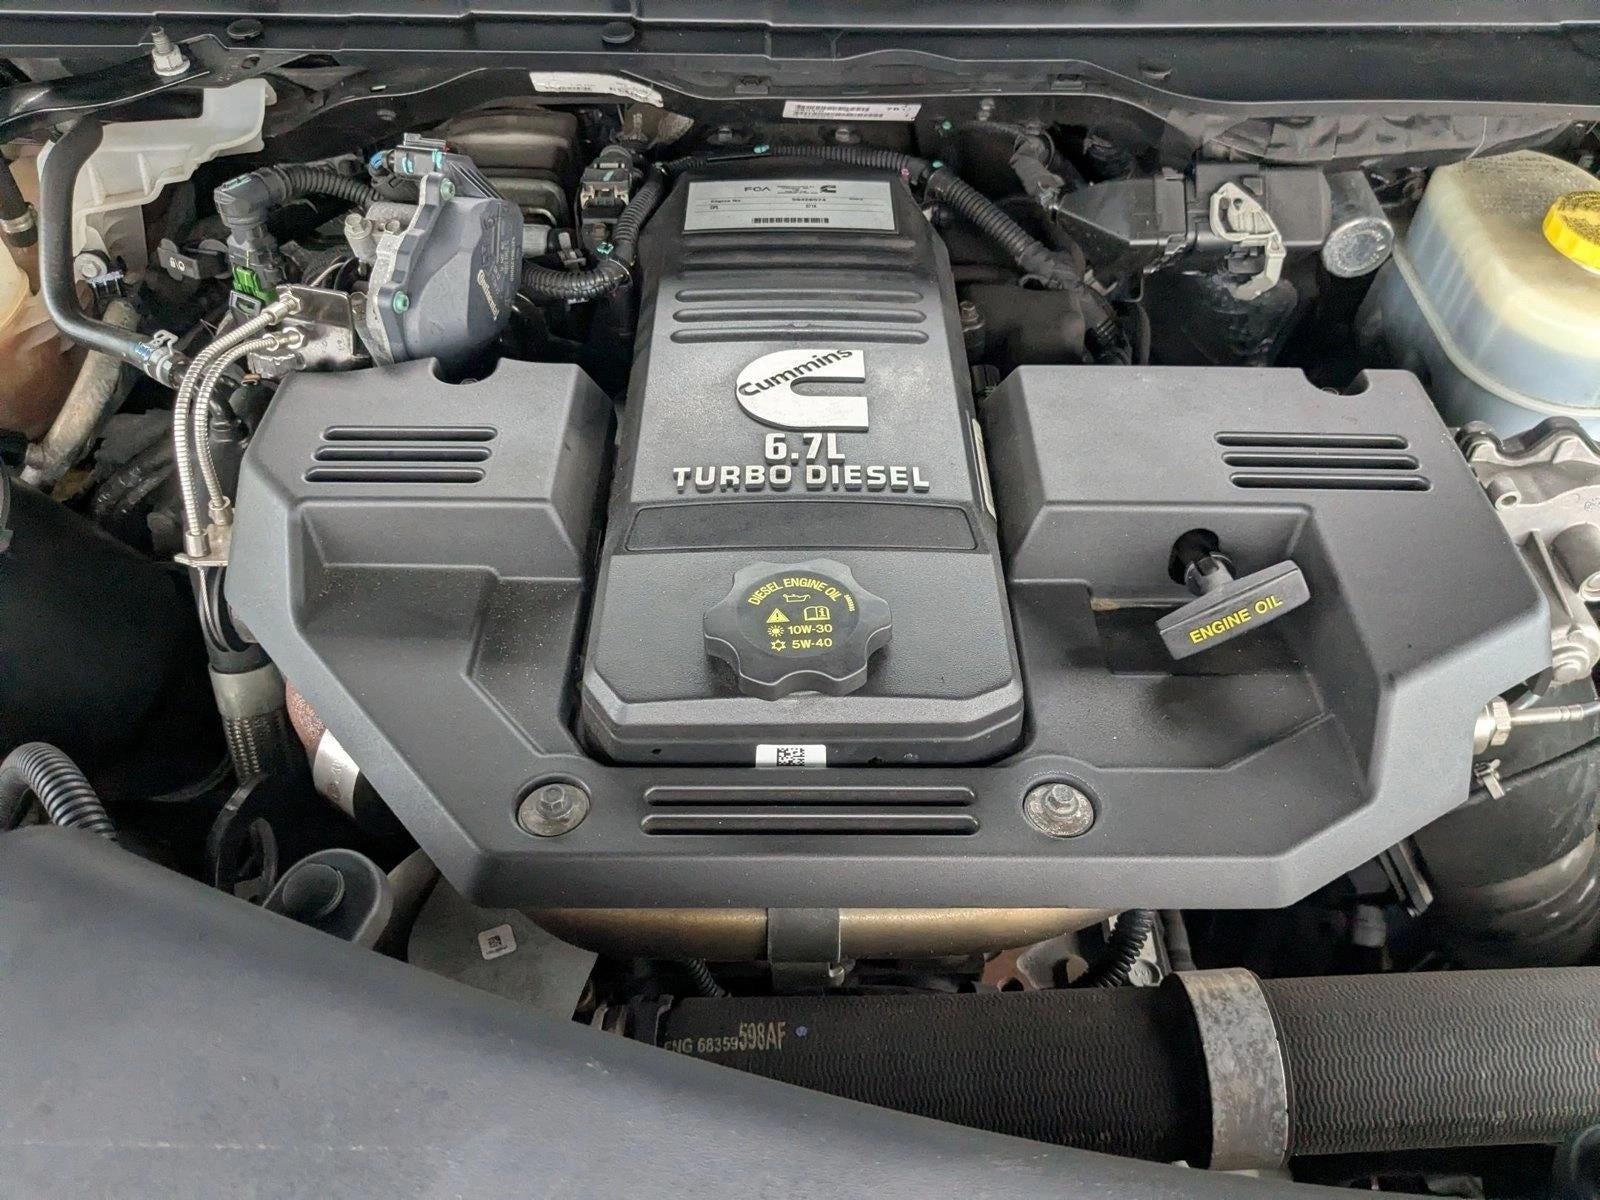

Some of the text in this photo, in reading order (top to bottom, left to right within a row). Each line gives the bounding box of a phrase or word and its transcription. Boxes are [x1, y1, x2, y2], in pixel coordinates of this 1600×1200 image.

[738, 348, 853, 396] Cummins
[765, 432, 846, 464] 6.7L
[673, 464, 930, 493] TURBO DIESEL
[748, 577, 843, 606] DIESEL ENGINE OIL
[788, 623, 833, 635] 10W-30
[1189, 595, 1284, 644] ENGINE OIL
[792, 638, 833, 650] 5W-40
